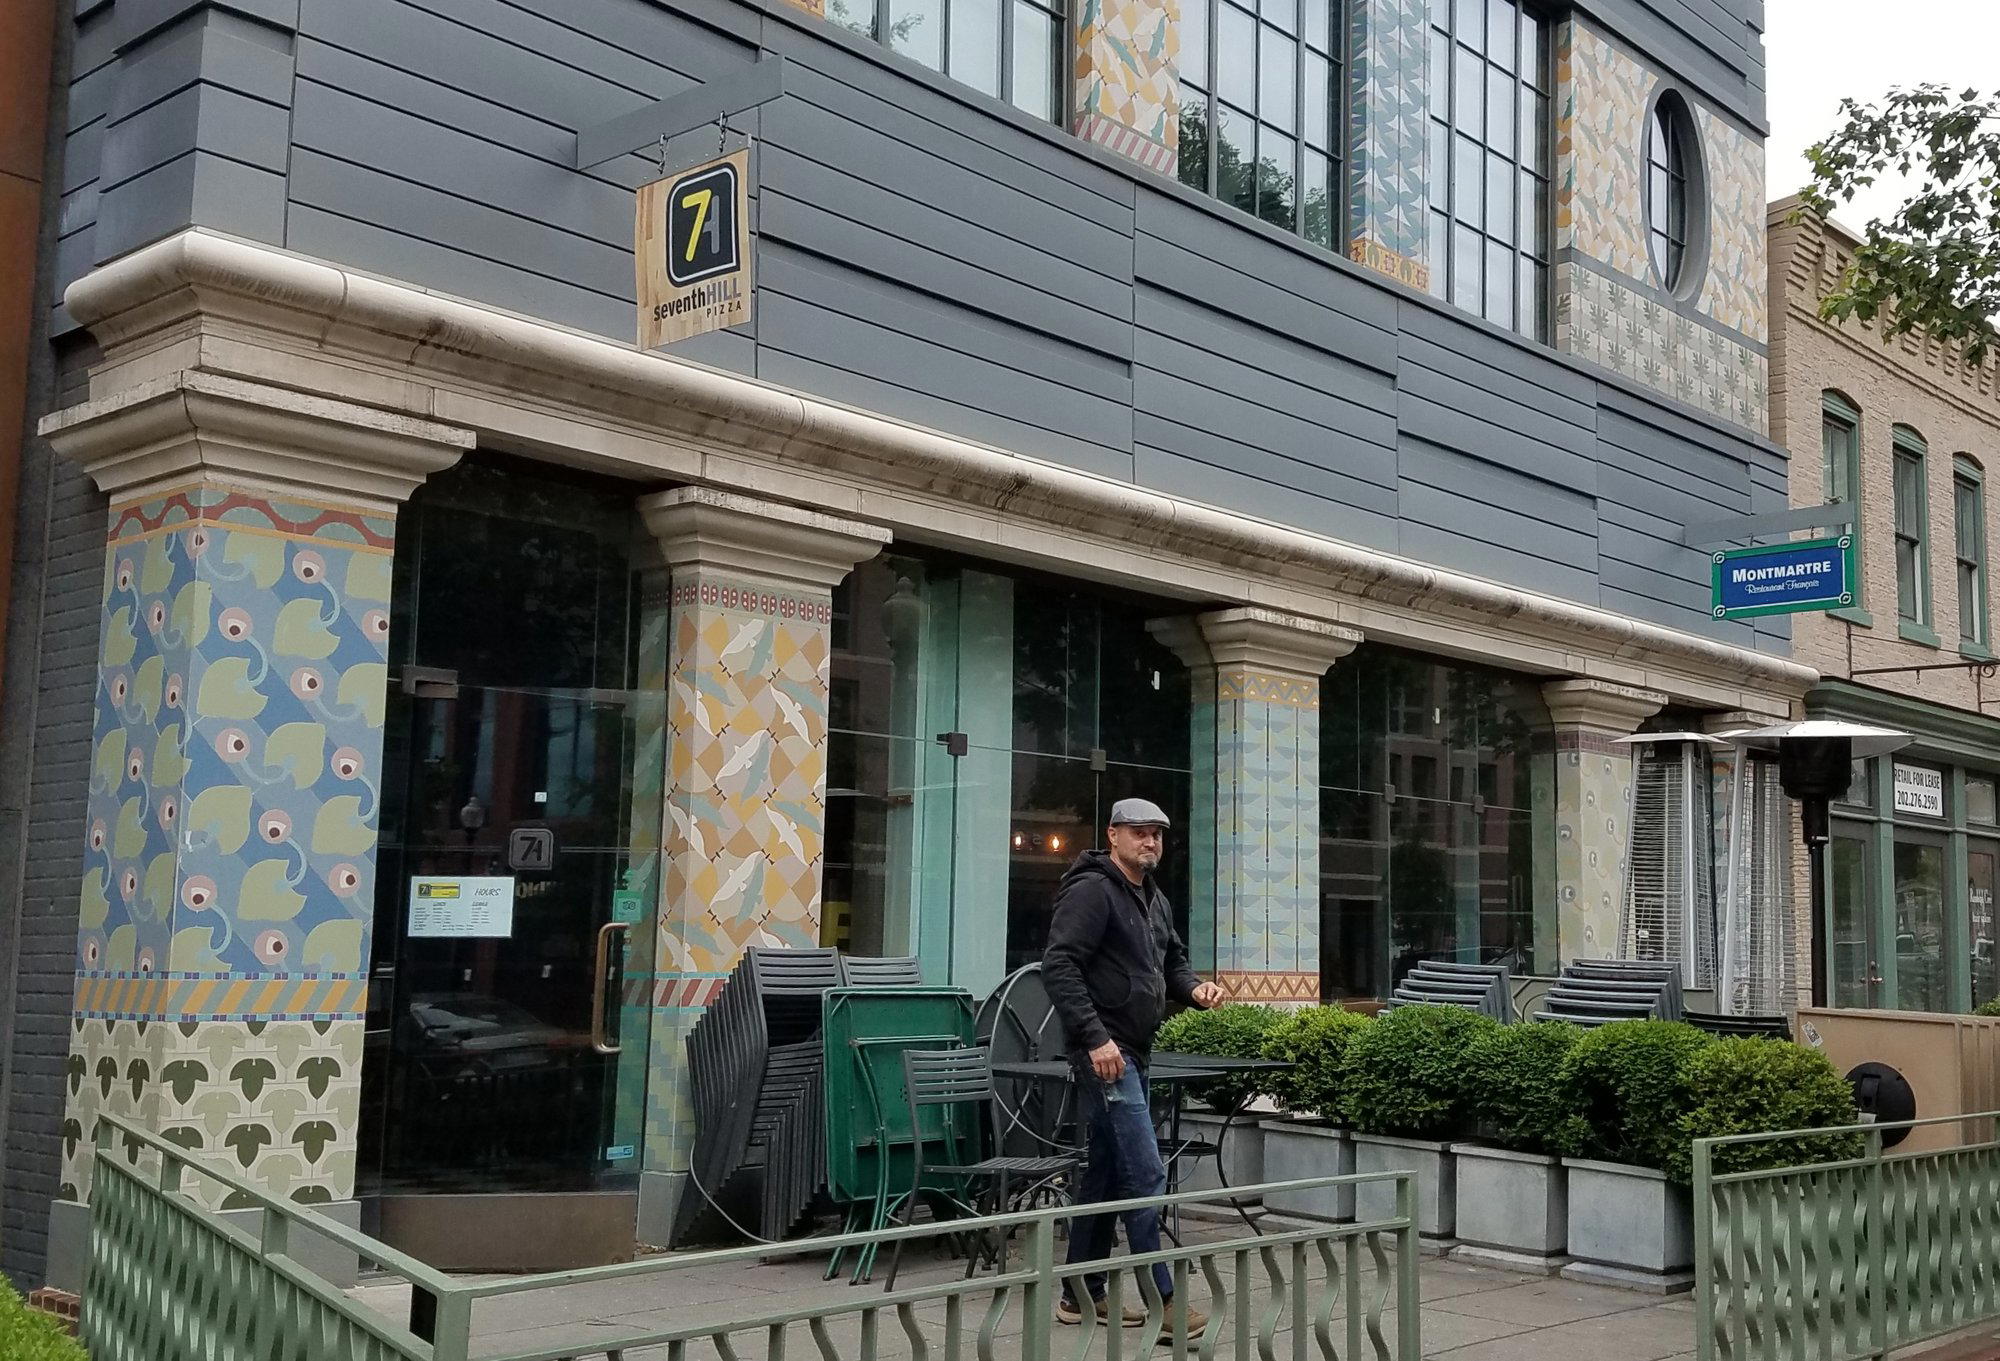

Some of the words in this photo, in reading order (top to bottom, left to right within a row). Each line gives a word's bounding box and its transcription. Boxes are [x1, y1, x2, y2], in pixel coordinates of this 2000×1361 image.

[706, 300, 742, 318] PIZZA
[1732, 561, 1832, 583] MONTMARTRE
[1893, 769, 1912, 784] RETAIL
[1913, 772, 1924, 786] FOR
[1925, 774, 1939, 789] LEASE
[1897, 790, 1938, 810] 202.276.2590
[474, 887, 501, 897] HOURS
